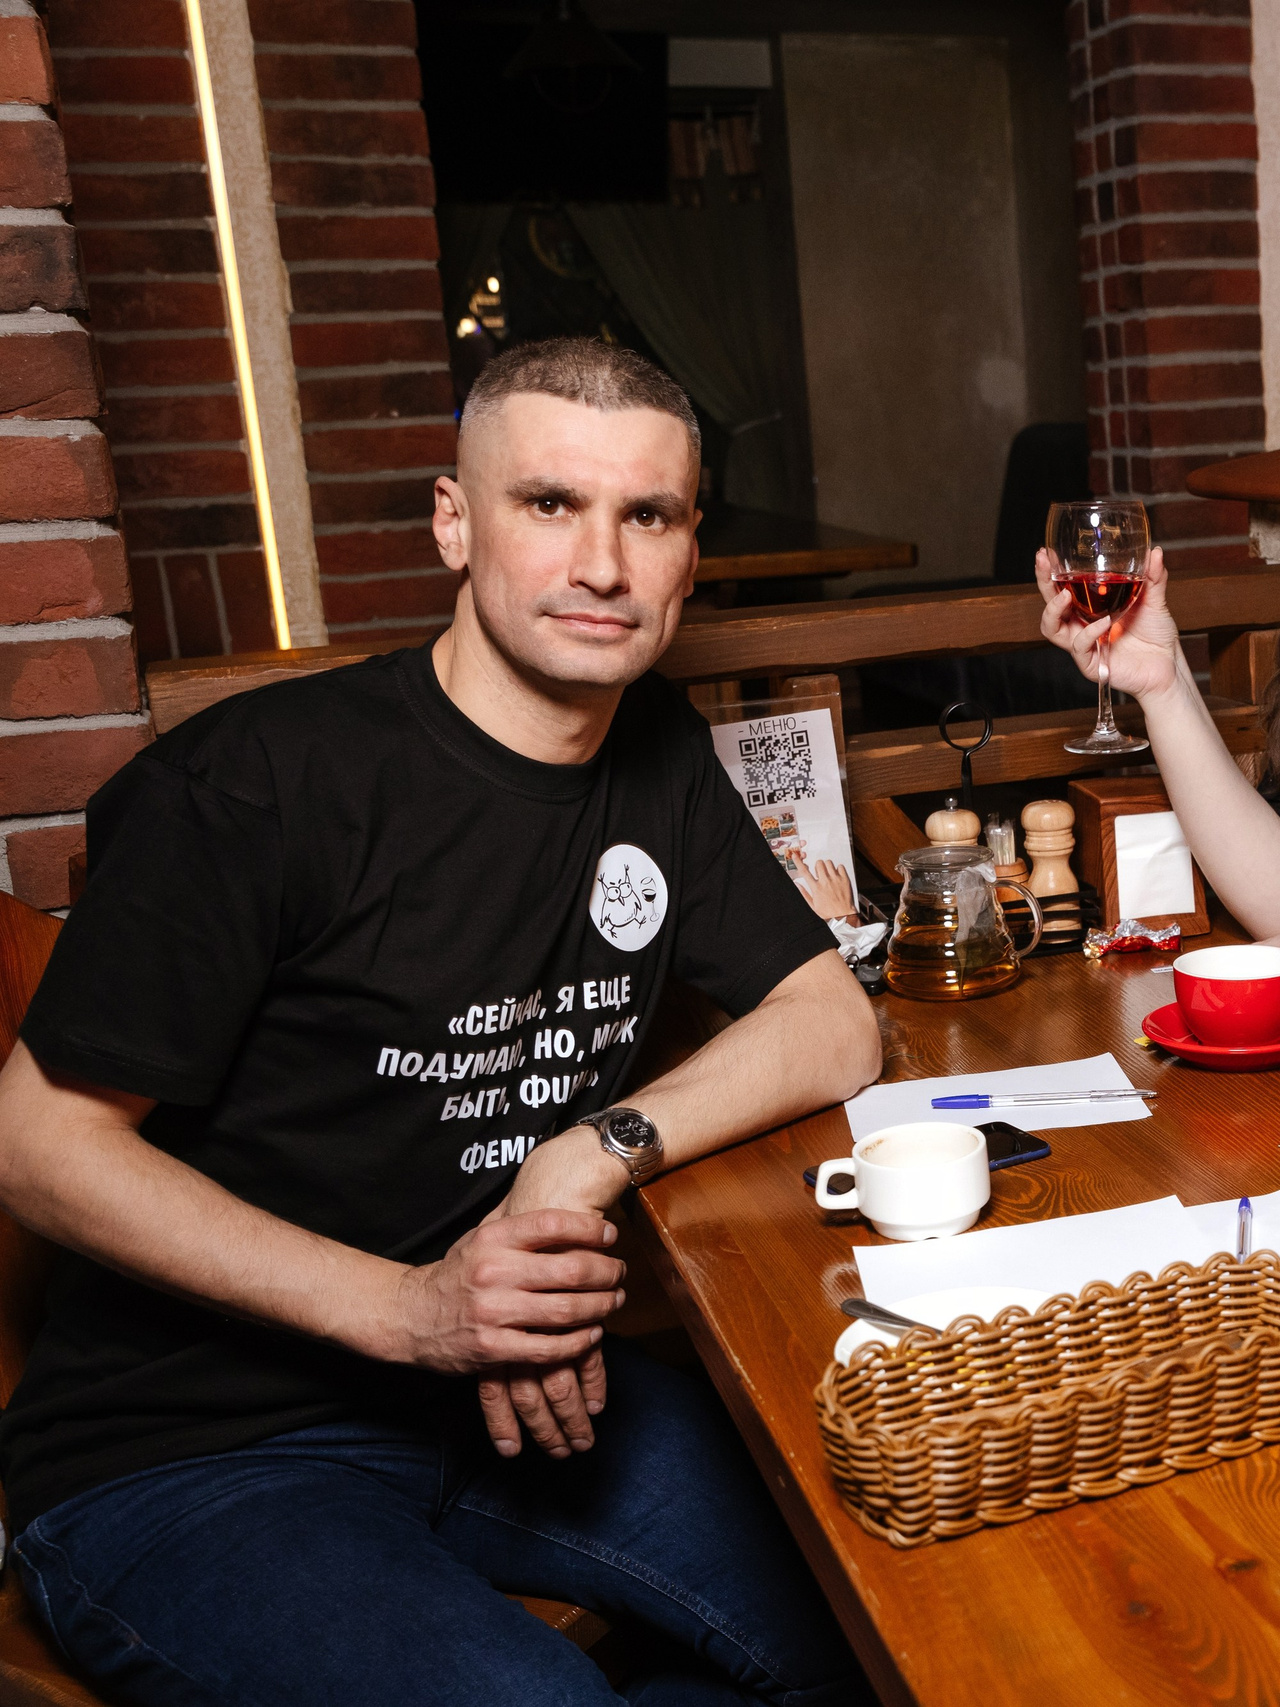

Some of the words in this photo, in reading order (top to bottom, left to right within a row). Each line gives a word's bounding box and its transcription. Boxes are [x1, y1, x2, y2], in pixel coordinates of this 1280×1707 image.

[748, 716, 797, 737] МЕНЮ
[555, 985, 575, 1013] Я
[583, 975, 631, 1011] ЕЩЕ
[534, 1028, 585, 1062] НО,
